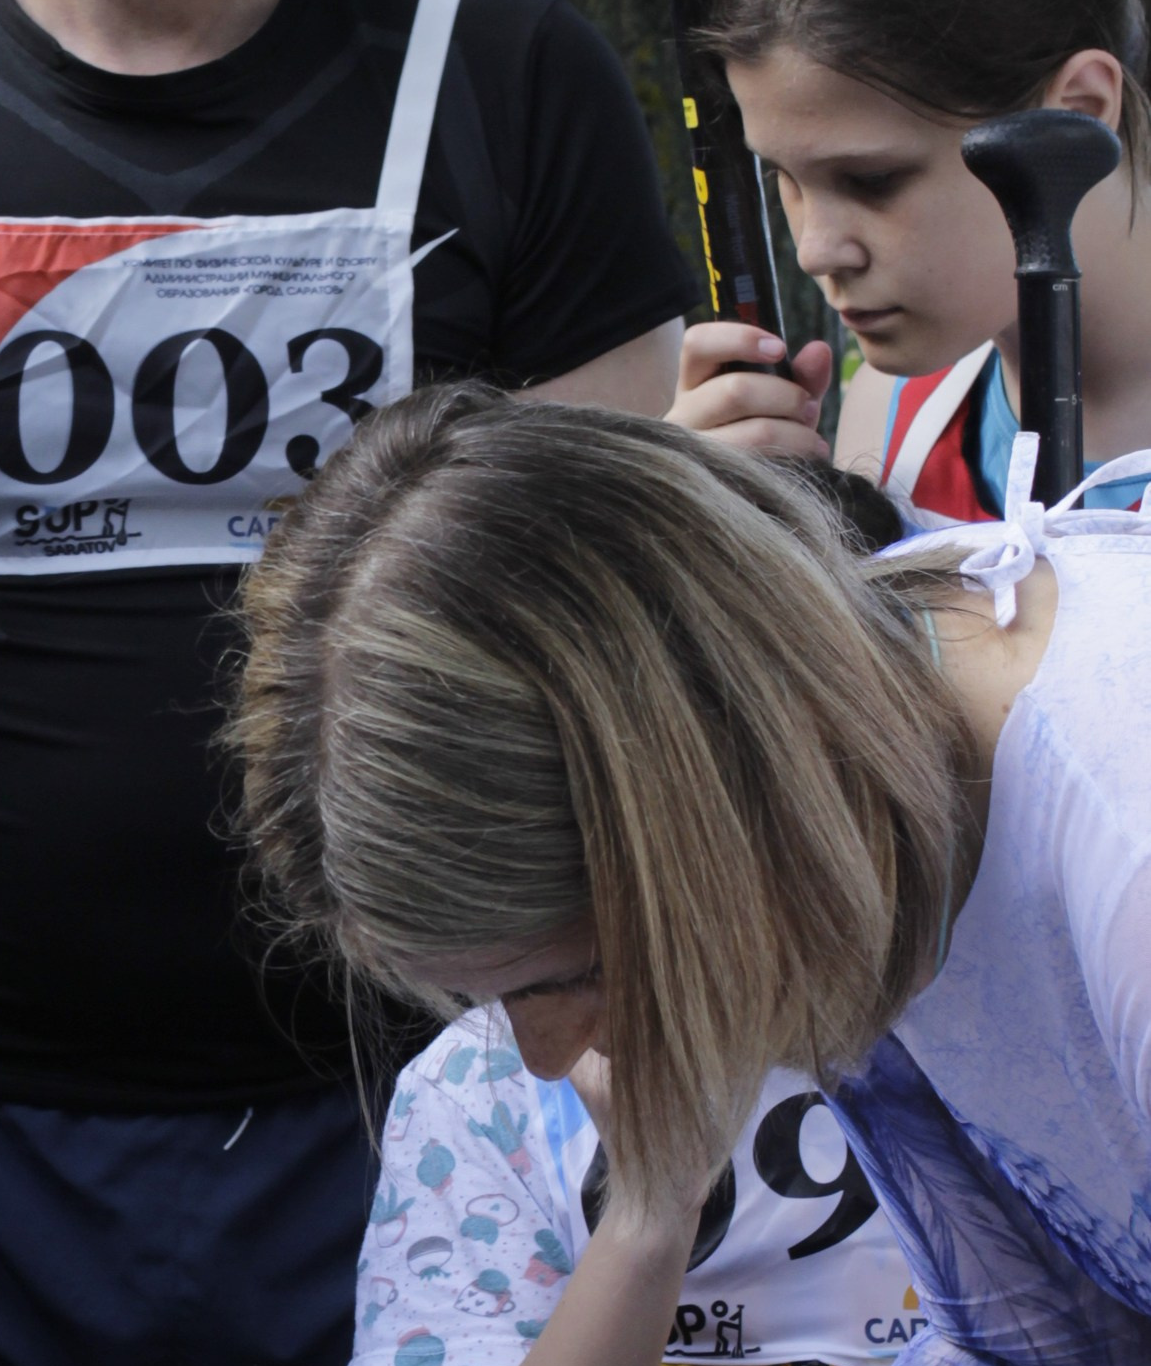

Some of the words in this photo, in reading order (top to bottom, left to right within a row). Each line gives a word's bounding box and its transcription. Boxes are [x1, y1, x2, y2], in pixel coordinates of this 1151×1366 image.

[173, 259, 192, 270] ПО
[195, 254, 272, 270] ФИЗИЧЕСКОЙ
[145, 271, 249, 284] АДМИНИСТРАЦИИ
[250, 270, 357, 283] МУНИЦИПАЛЬНОГО
[156, 287, 240, 299] ОБРАЗОВАНИЯ
[1052, 283, 1068, 292] cm
[1070, 394, 1078, 406] 5
[44, 539, 117, 557] SARATOV
